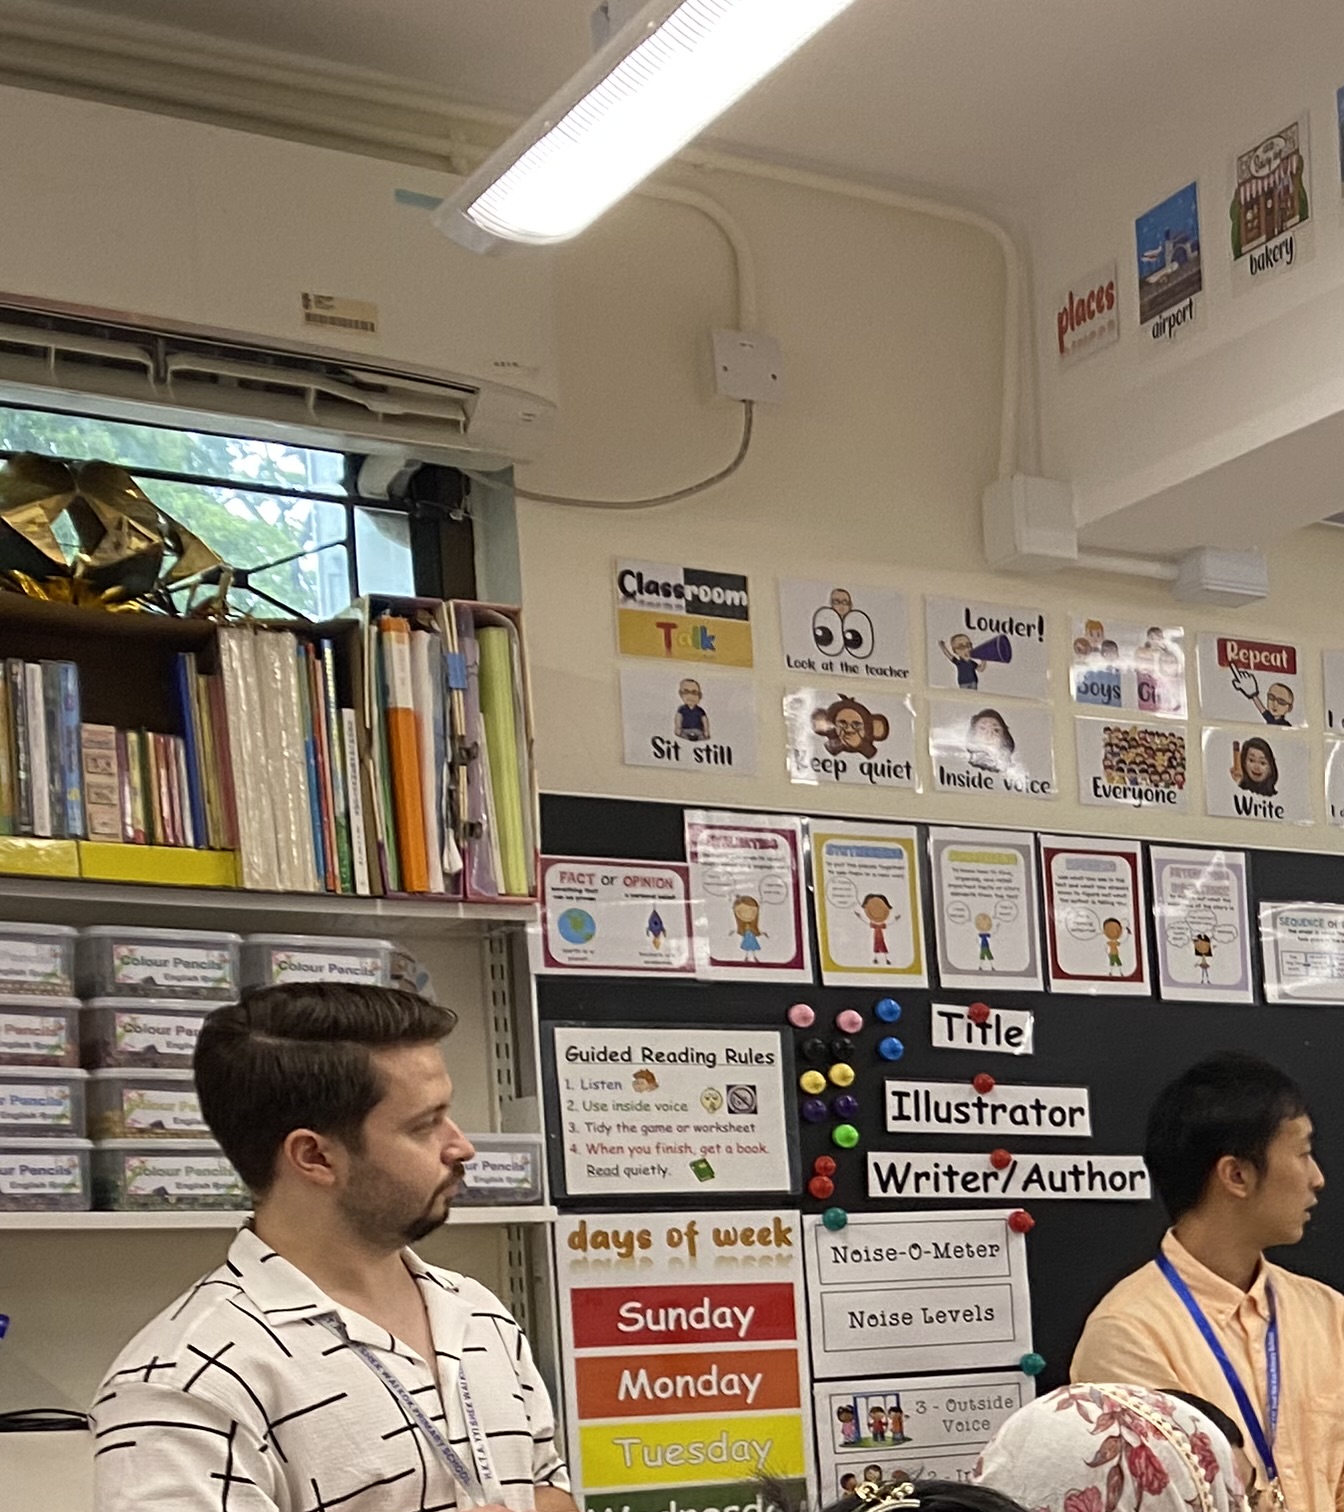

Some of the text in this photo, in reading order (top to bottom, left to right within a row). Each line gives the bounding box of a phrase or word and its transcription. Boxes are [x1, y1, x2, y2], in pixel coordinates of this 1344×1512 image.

[1249, 235, 1294, 276] bakery
[1057, 278, 1116, 355] places
[1152, 299, 1194, 340] airport
[618, 570, 748, 607] Classroom
[964, 609, 1045, 642] Louder!
[656, 622, 716, 657] Talk
[787, 654, 909, 678] Look at the teacher
[1227, 641, 1288, 669] Repeat
[1328, 711, 1333, 728] I
[652, 737, 732, 766] Sit still
[860, 759, 912, 783] quiet
[939, 766, 1051, 794] Inside voice
[1092, 777, 1177, 808] Everyone
[1234, 796, 1284, 819] Write
[560, 871, 595, 885] FACT
[624, 877, 673, 889] OPINION
[121, 955, 222, 970] Colour Pencils
[279, 961, 375, 976] Colour Pencils
[937, 1011, 1023, 1046] Title
[566, 1046, 774, 1068] Guided Reading Rules
[581, 1079, 622, 1090] Listen
[567, 1101, 688, 1112] 2. Use inside voice
[891, 1090, 1084, 1127] Illustrator
[568, 1122, 755, 1139] 3. Tidy the game or worksheet
[586, 1143, 624, 1154] When
[629, 1145, 651, 1158] you
[700, 1144, 720, 1158] get
[726, 1145, 732, 1153] a
[588, 1164, 671, 1179] Read quietly.
[874, 1160, 1146, 1192] Writer/Author
[568, 1218, 793, 1258] days of week
[832, 1243, 1000, 1264] Noise-O-Meter
[617, 1297, 754, 1337] Sunday
[849, 1306, 994, 1329] Noise Levels
[618, 1365, 763, 1402] Monday
[916, 1397, 1013, 1414] 3 Outside
[942, 1419, 991, 1432] Voice
[613, 1432, 772, 1468] Tuesday
